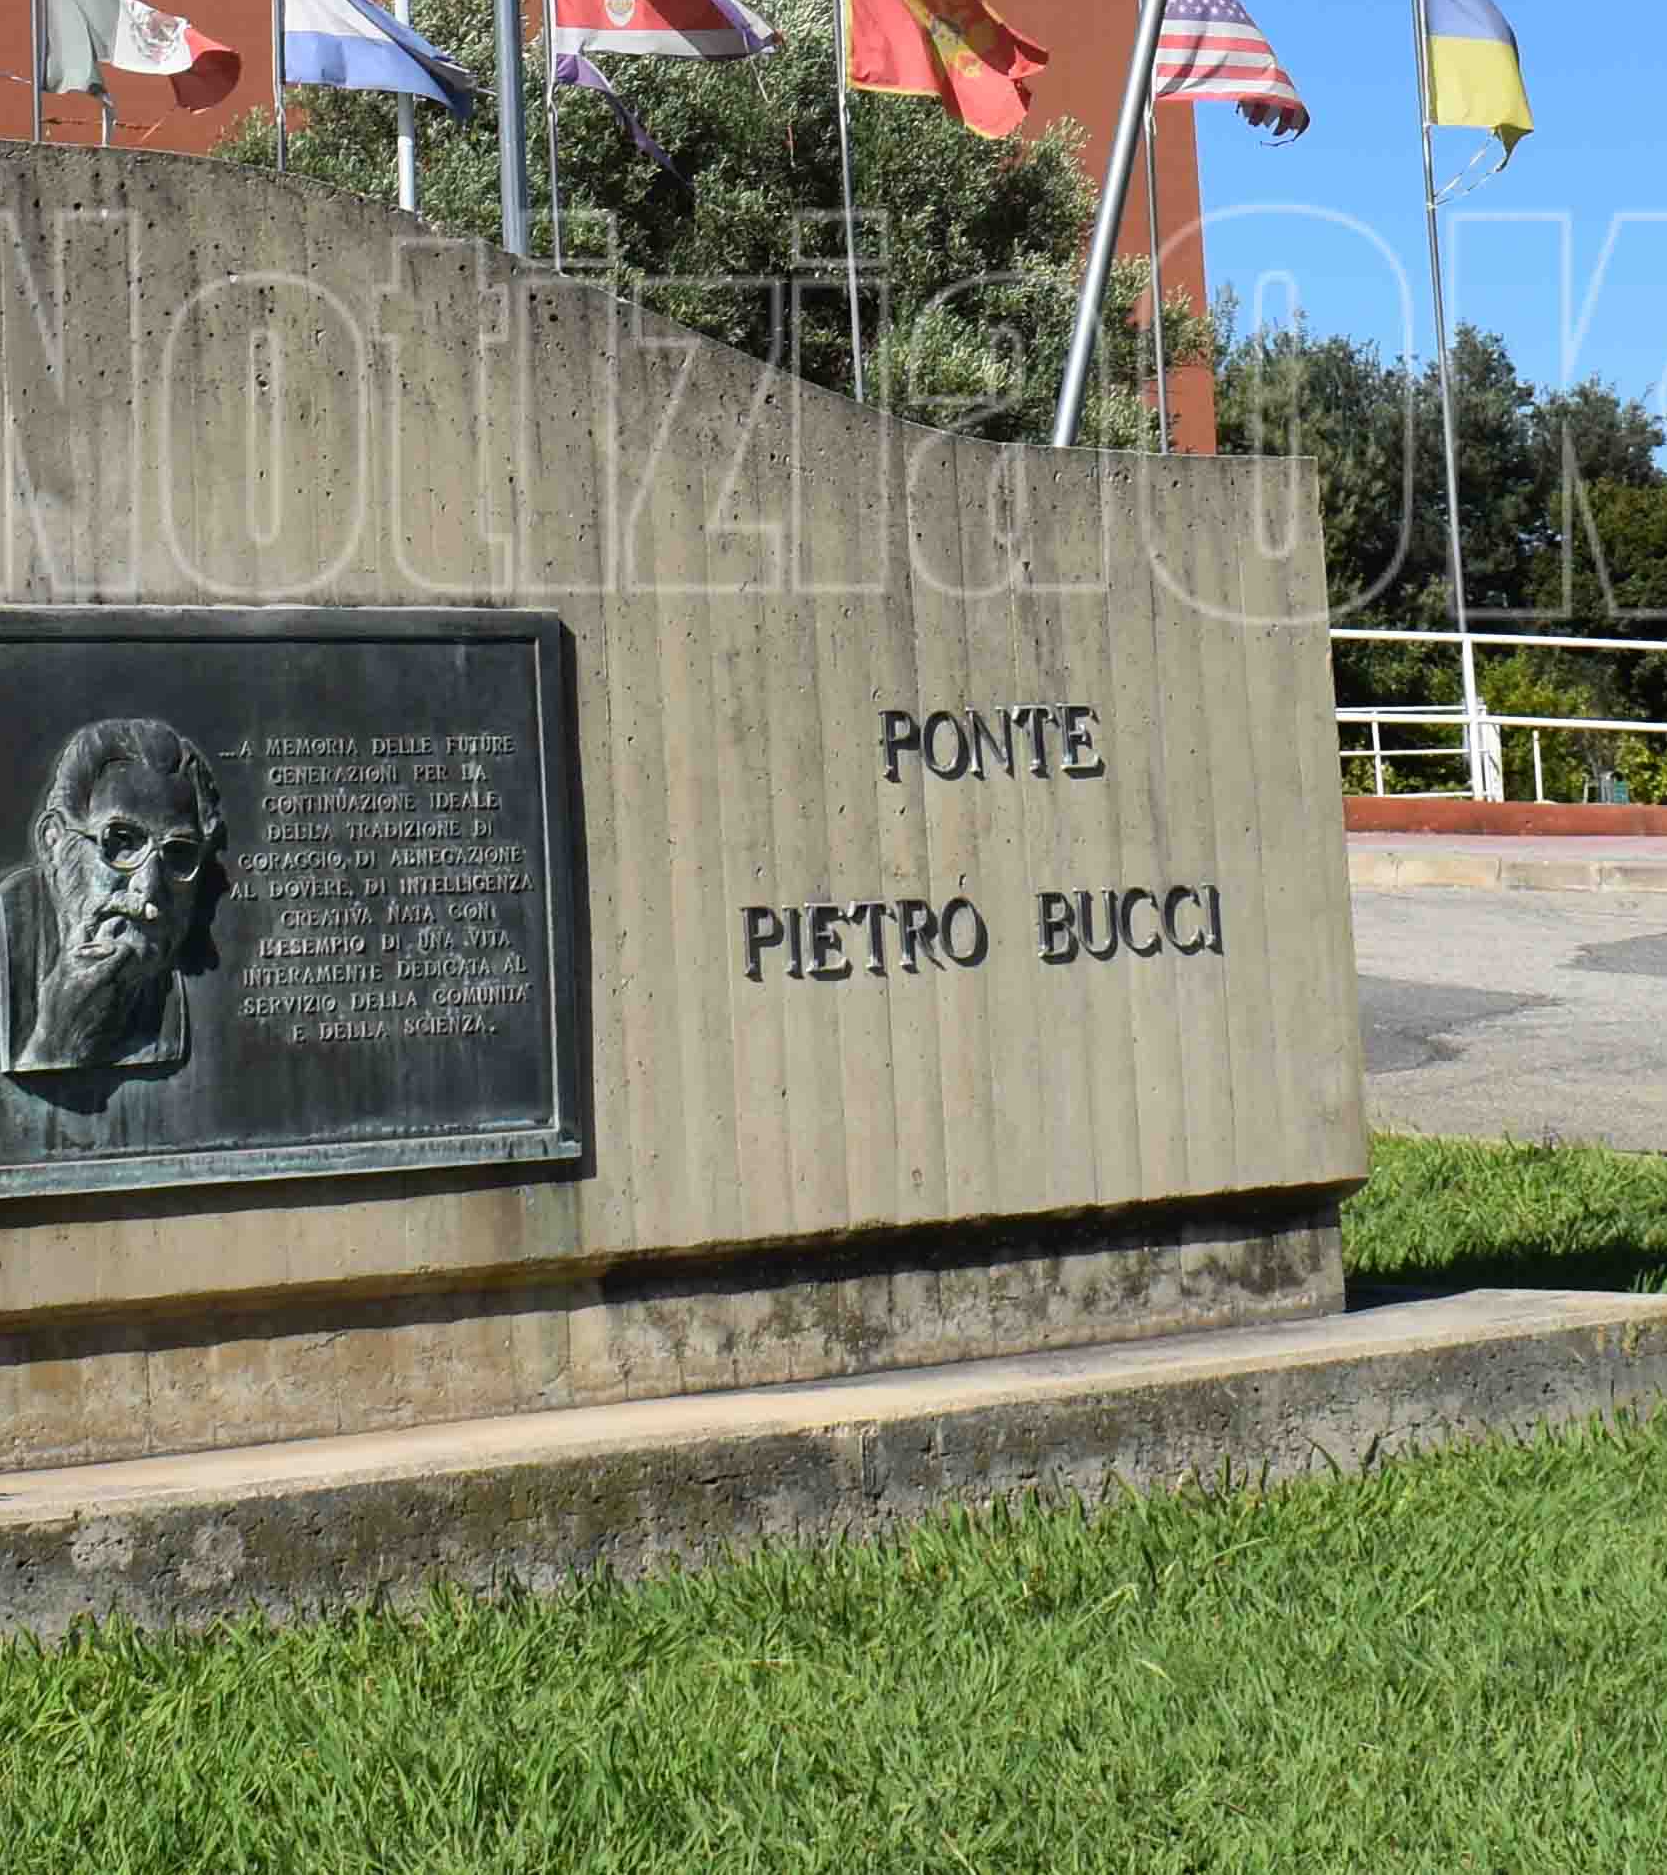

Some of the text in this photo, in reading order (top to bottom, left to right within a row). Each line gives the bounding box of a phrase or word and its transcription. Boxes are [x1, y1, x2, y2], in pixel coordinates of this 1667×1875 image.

[265, 737, 359, 758] MEMORIA
[371, 736, 433, 757] DELLE
[445, 733, 516, 757] FUTURE
[878, 702, 1106, 782] PONTE
[268, 763, 488, 786] GENERAZIONI PER LA
[261, 790, 501, 814] CONTINUAZIONE IDEALE
[265, 819, 495, 842] DELLA TRADIZIONE DI
[237, 845, 526, 871] CORAGGIO, DI ABNEGAZIONE
[229, 879, 257, 901] AL
[364, 875, 387, 896] DI
[399, 871, 536, 895] INTELLIGENZA
[280, 900, 496, 929] CREATIVA NATA CON
[381, 932, 401, 952] DI
[417, 928, 454, 952] UNA
[468, 928, 512, 949] VITA
[740, 883, 1224, 982] PIETRO BUCCI
[242, 953, 529, 988] INTERAMENTE DEDICATA AL
[242, 992, 337, 1017] SERVIZIO
[350, 988, 419, 1012] DELLA
[291, 1022, 306, 1044] E
[319, 1020, 390, 1041] DELLA
